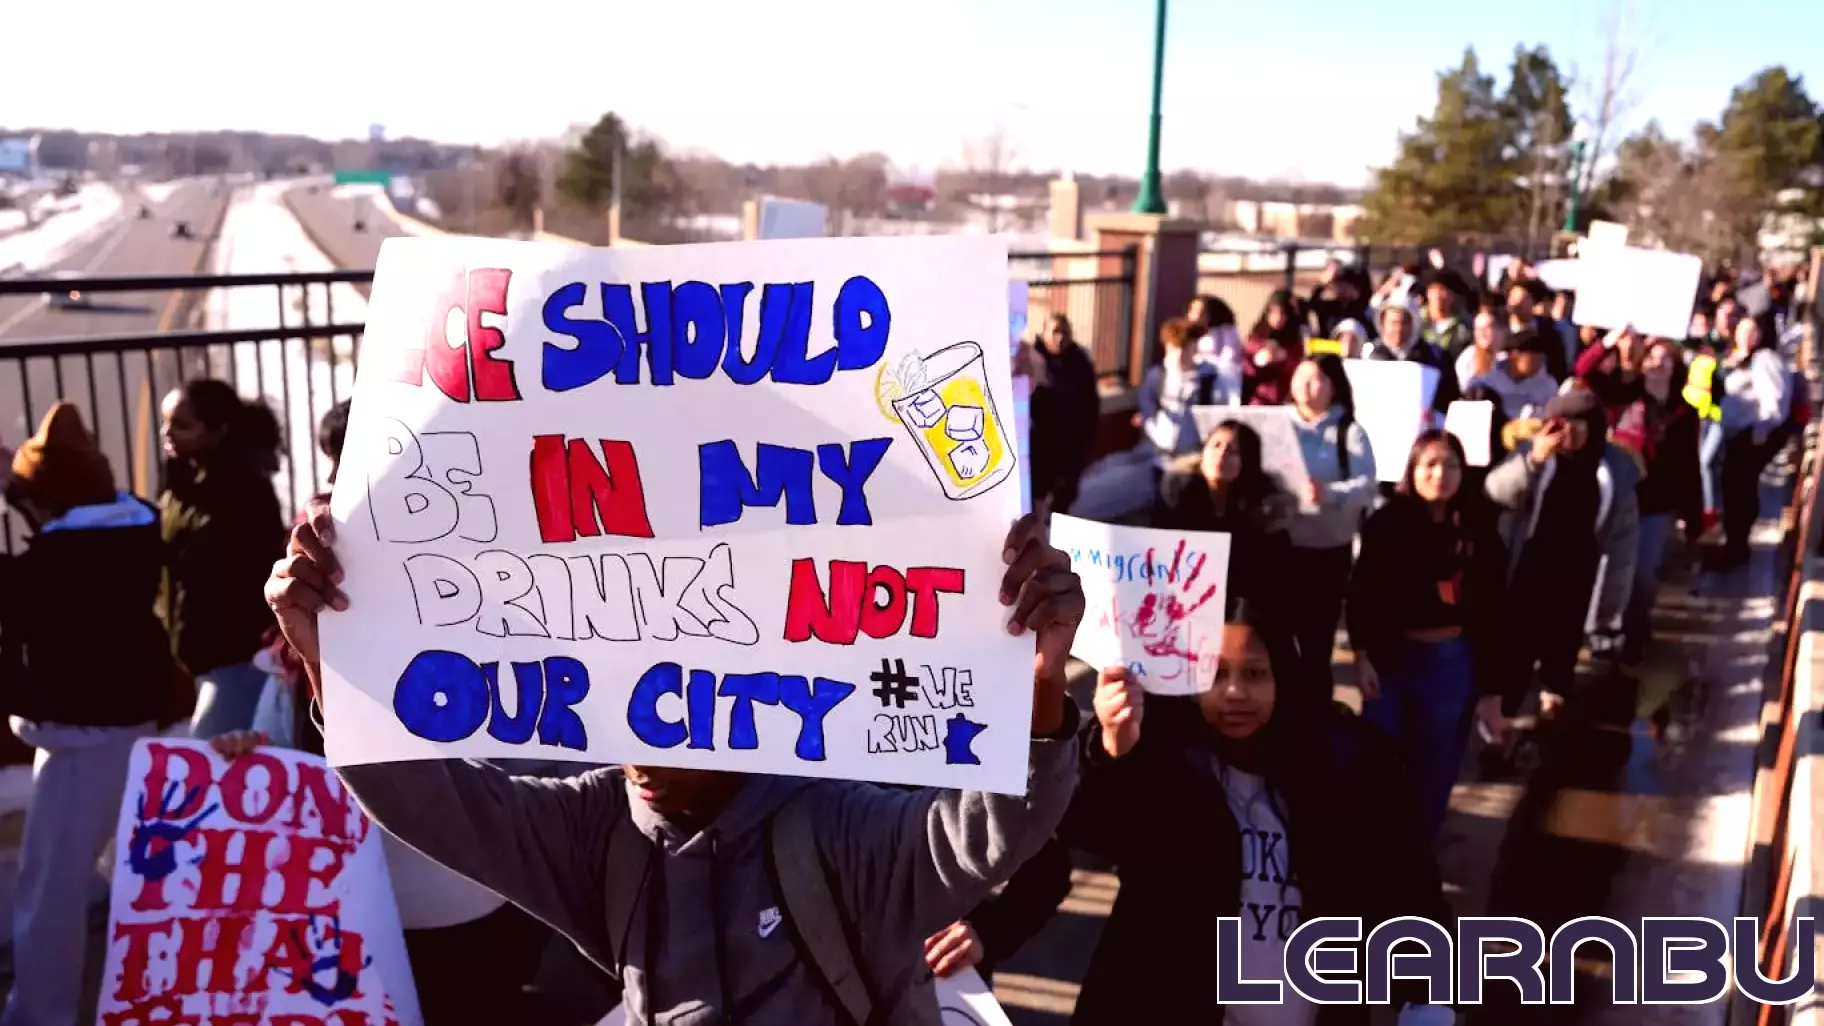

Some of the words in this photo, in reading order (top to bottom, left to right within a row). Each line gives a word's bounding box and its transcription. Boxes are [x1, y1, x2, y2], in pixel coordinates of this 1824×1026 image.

[541, 275, 891, 392] SHOULD
[366, 415, 499, 544] BE
[530, 433, 655, 543] IN
[699, 436, 894, 531] MY
[402, 542, 760, 646] DRINKS
[783, 556, 966, 646] NOT
[392, 649, 590, 751] OUR
[626, 660, 857, 762] CITY
[869, 657, 975, 710] #WE
[867, 713, 940, 754] RUN
[130, 825, 358, 918] THE
[113, 913, 365, 1003] THAT
